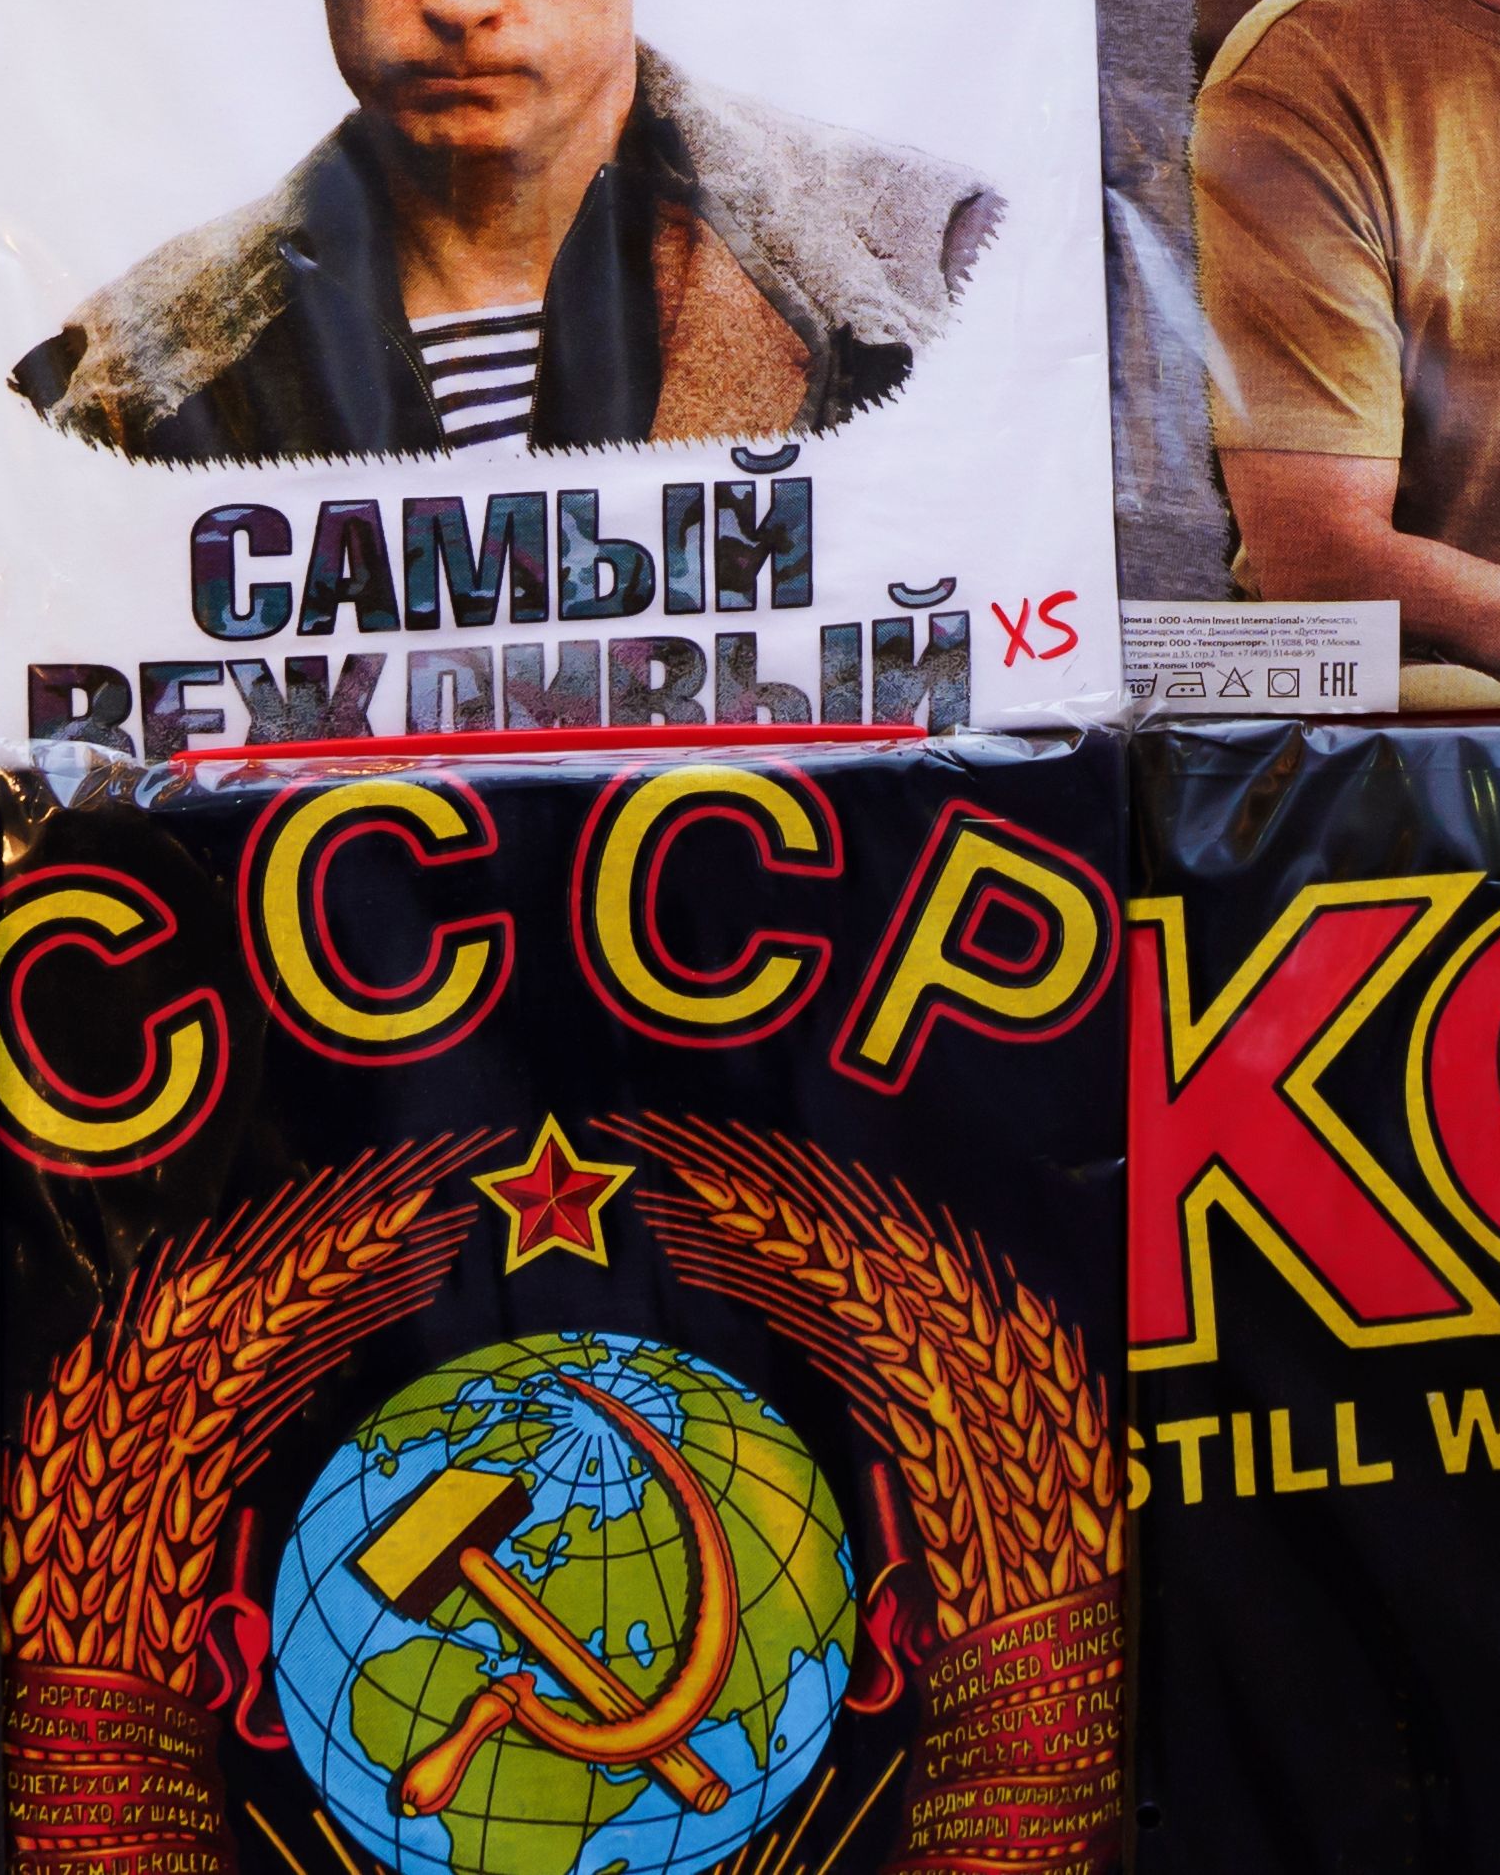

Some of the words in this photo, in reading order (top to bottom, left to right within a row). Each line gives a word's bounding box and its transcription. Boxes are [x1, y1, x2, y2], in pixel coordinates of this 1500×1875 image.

[191, 442, 812, 638] САМЫЙ
[992, 590, 1080, 668] XS
[991, 1618, 1058, 1656] MAADE
[931, 1655, 1041, 1716] TAARLASED
